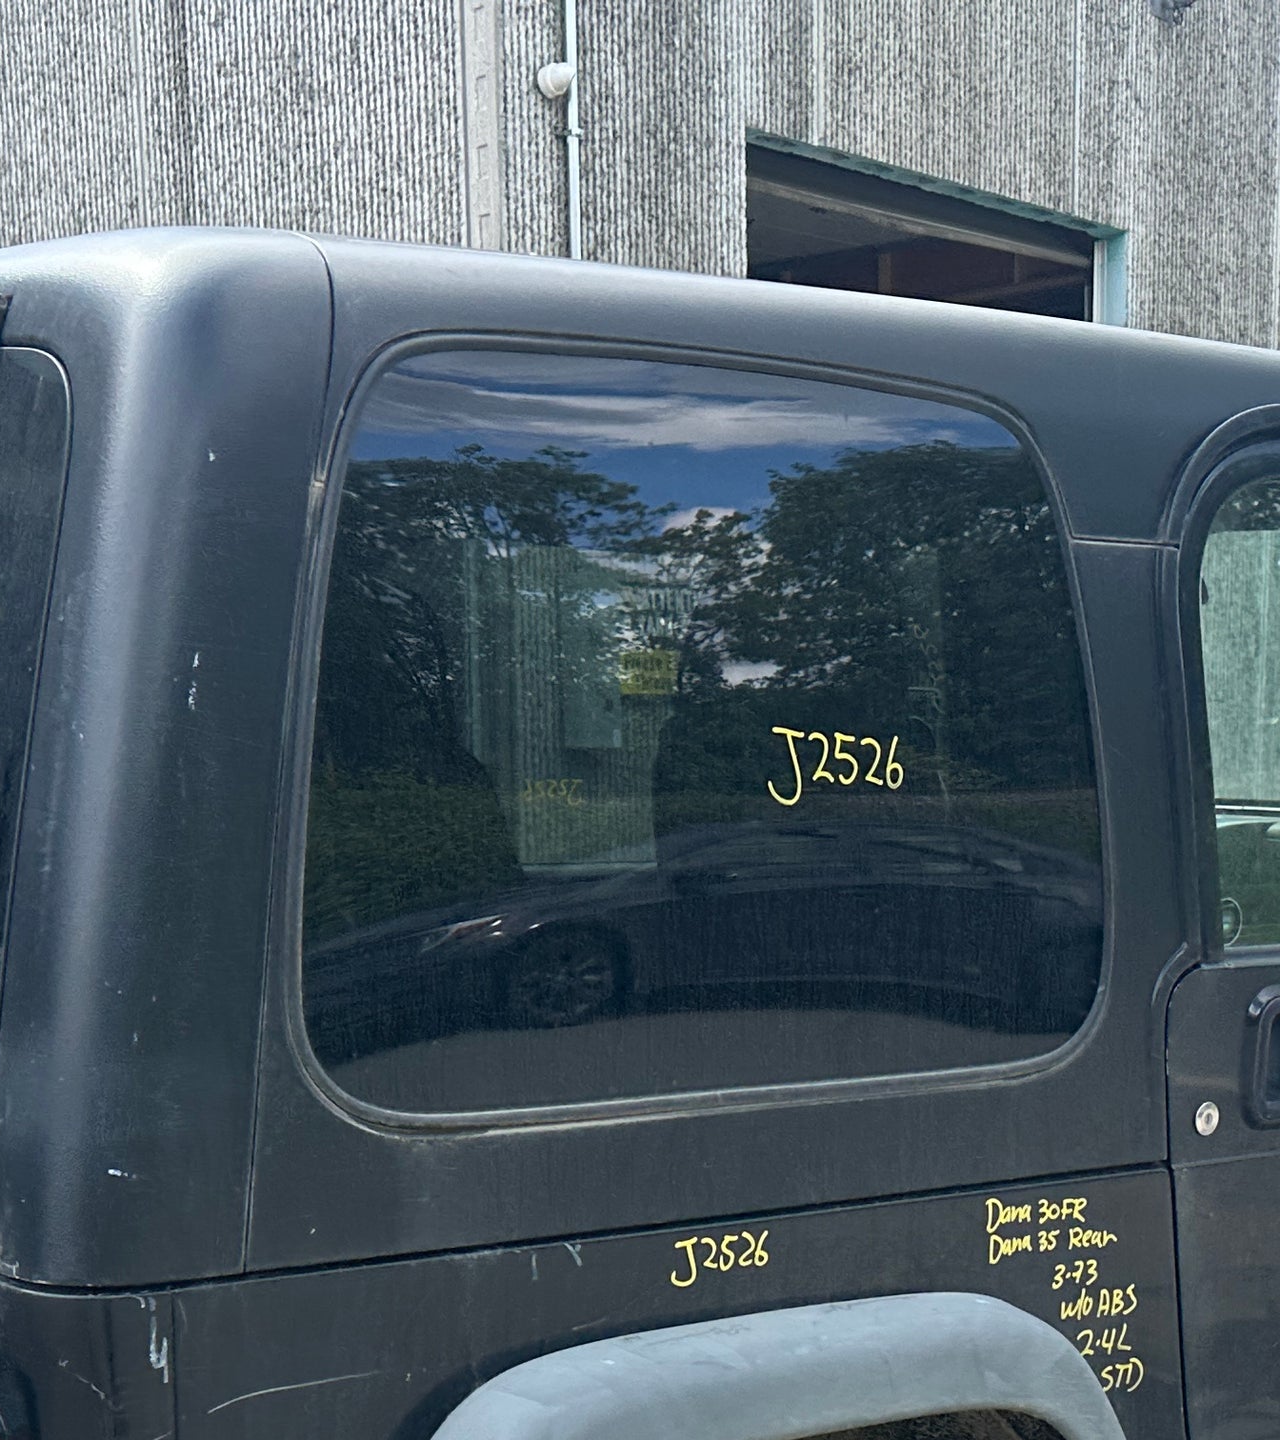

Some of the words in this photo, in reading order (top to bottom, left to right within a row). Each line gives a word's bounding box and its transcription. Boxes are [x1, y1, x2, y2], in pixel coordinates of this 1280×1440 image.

[768, 726, 904, 806] J2526
[985, 1198, 1032, 1233] Dana
[671, 1230, 769, 1287] J2526
[988, 1234, 1032, 1265] Dana
[1037, 1228, 1060, 1252] 35
[1068, 1226, 1118, 1250] Rear
[1096, 1283, 1138, 1318] ABS
